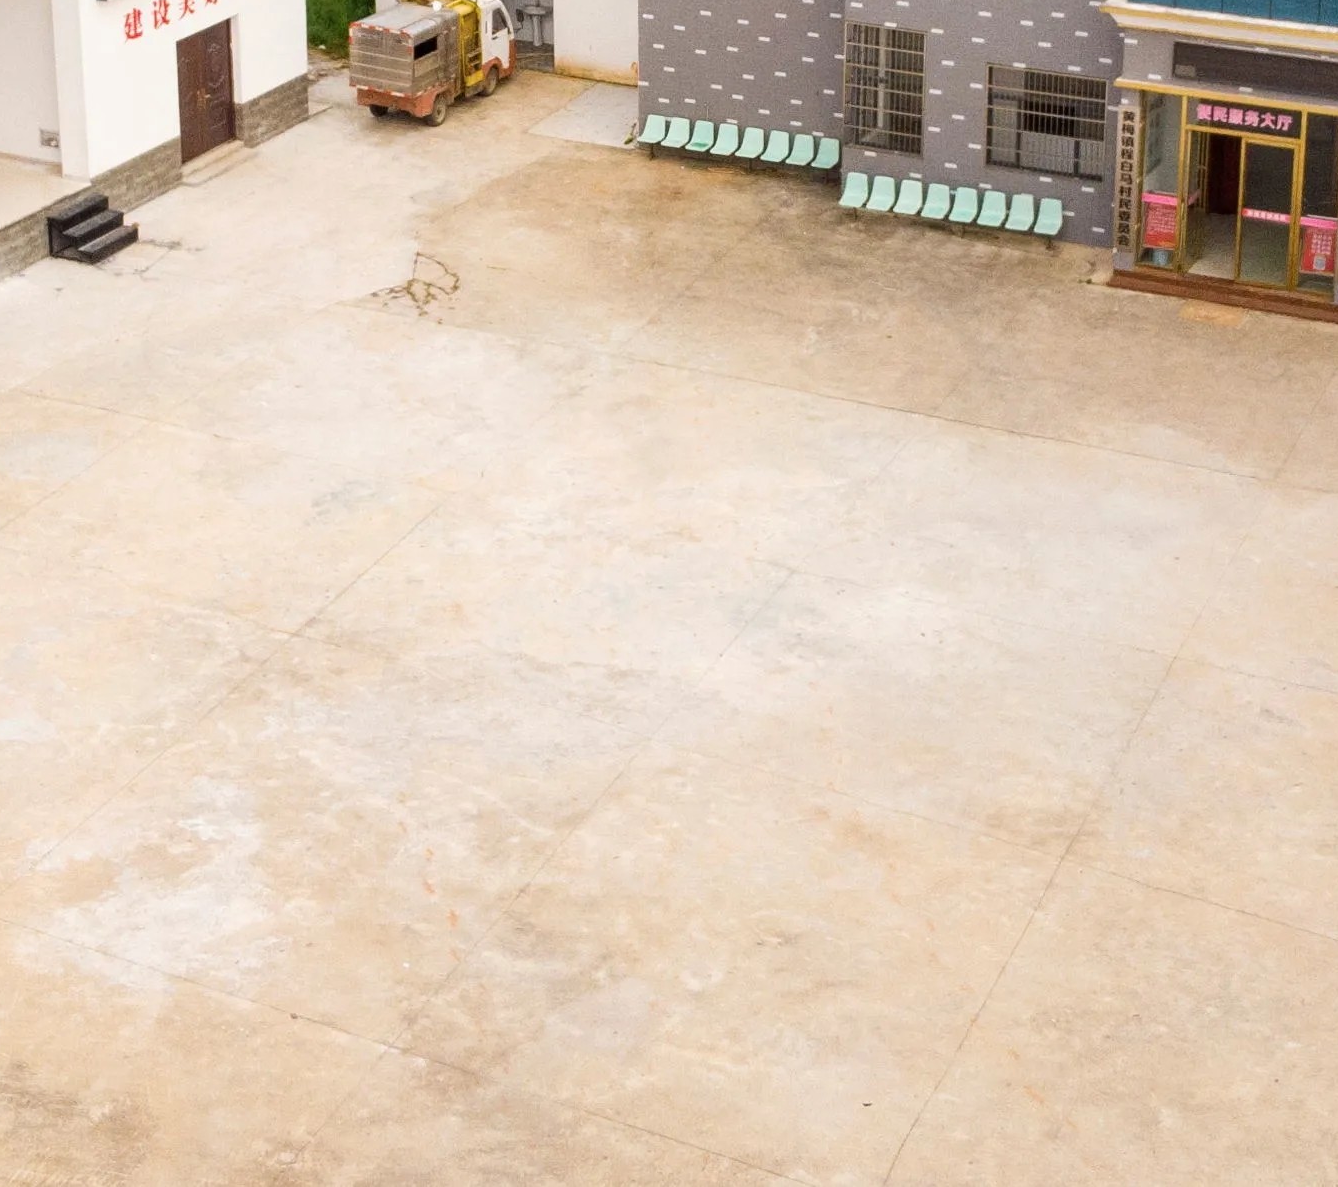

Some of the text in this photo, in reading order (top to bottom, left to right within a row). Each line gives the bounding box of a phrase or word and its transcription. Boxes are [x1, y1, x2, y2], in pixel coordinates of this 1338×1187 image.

[1196, 103, 1293, 131] 便民服务大厅
